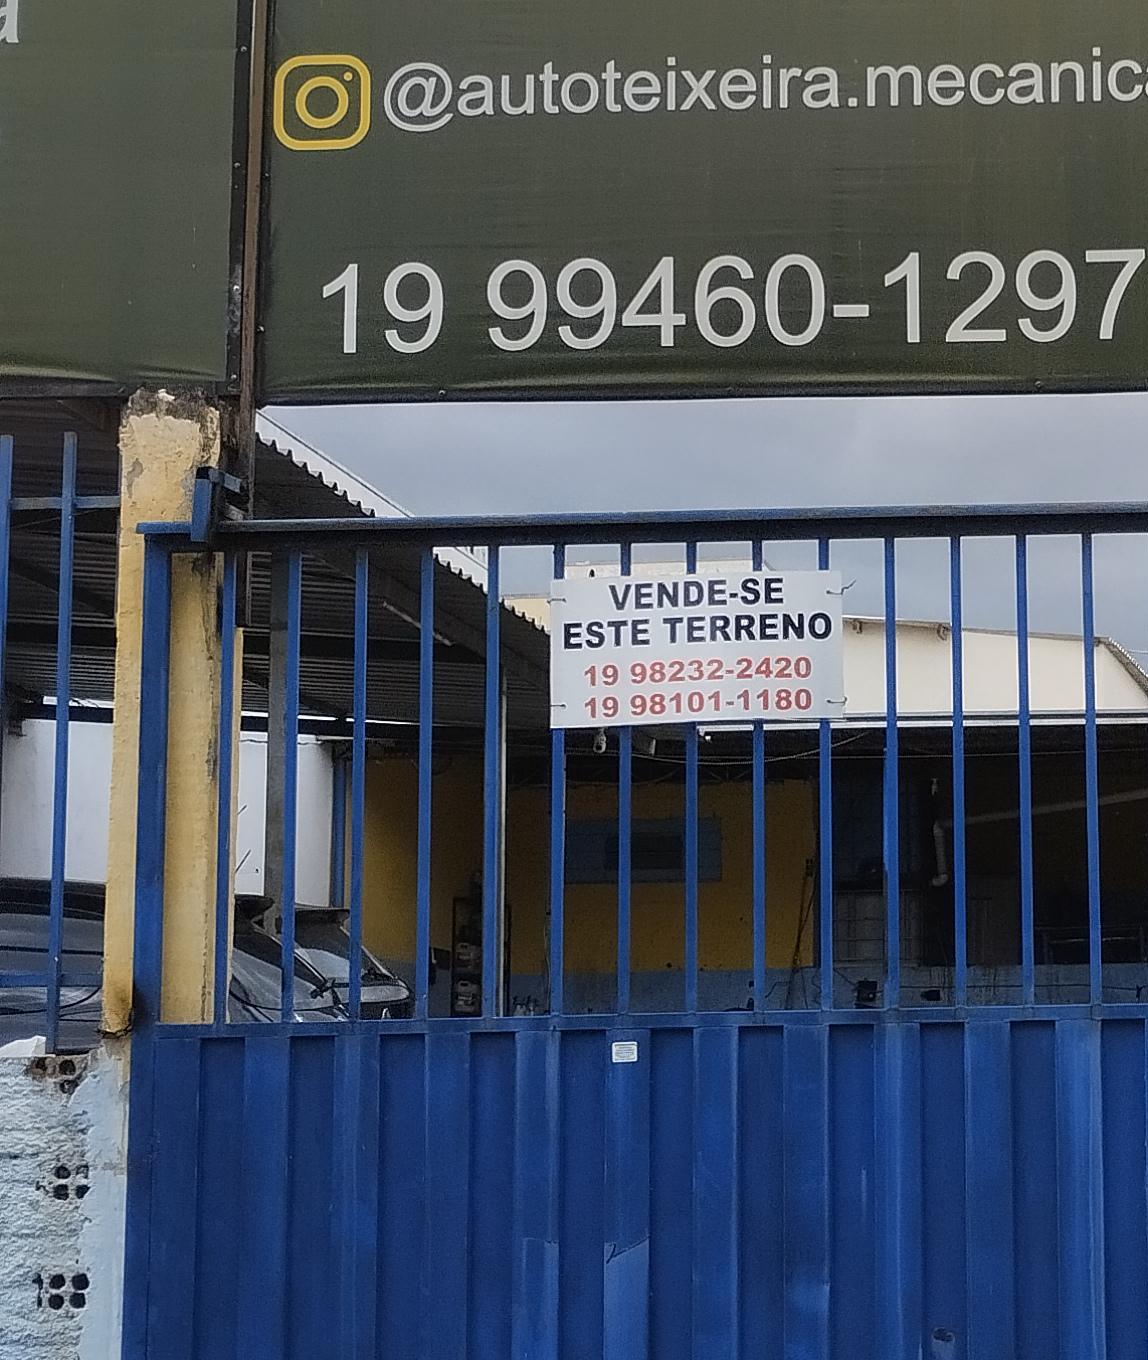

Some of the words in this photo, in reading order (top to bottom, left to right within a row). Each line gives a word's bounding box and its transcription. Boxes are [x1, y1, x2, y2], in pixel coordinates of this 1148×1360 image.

[322, 261, 444, 354] 19
[486, 248, 1146, 352] 99460-1297
[609, 577, 784, 611] VENDE-SE
[563, 618, 650, 649] ESTE
[663, 612, 832, 643] TERRENO
[584, 664, 619, 687] 19
[630, 656, 812, 684] 98232-2420
[584, 696, 619, 719] 19
[630, 688, 812, 716] 98101-1180
